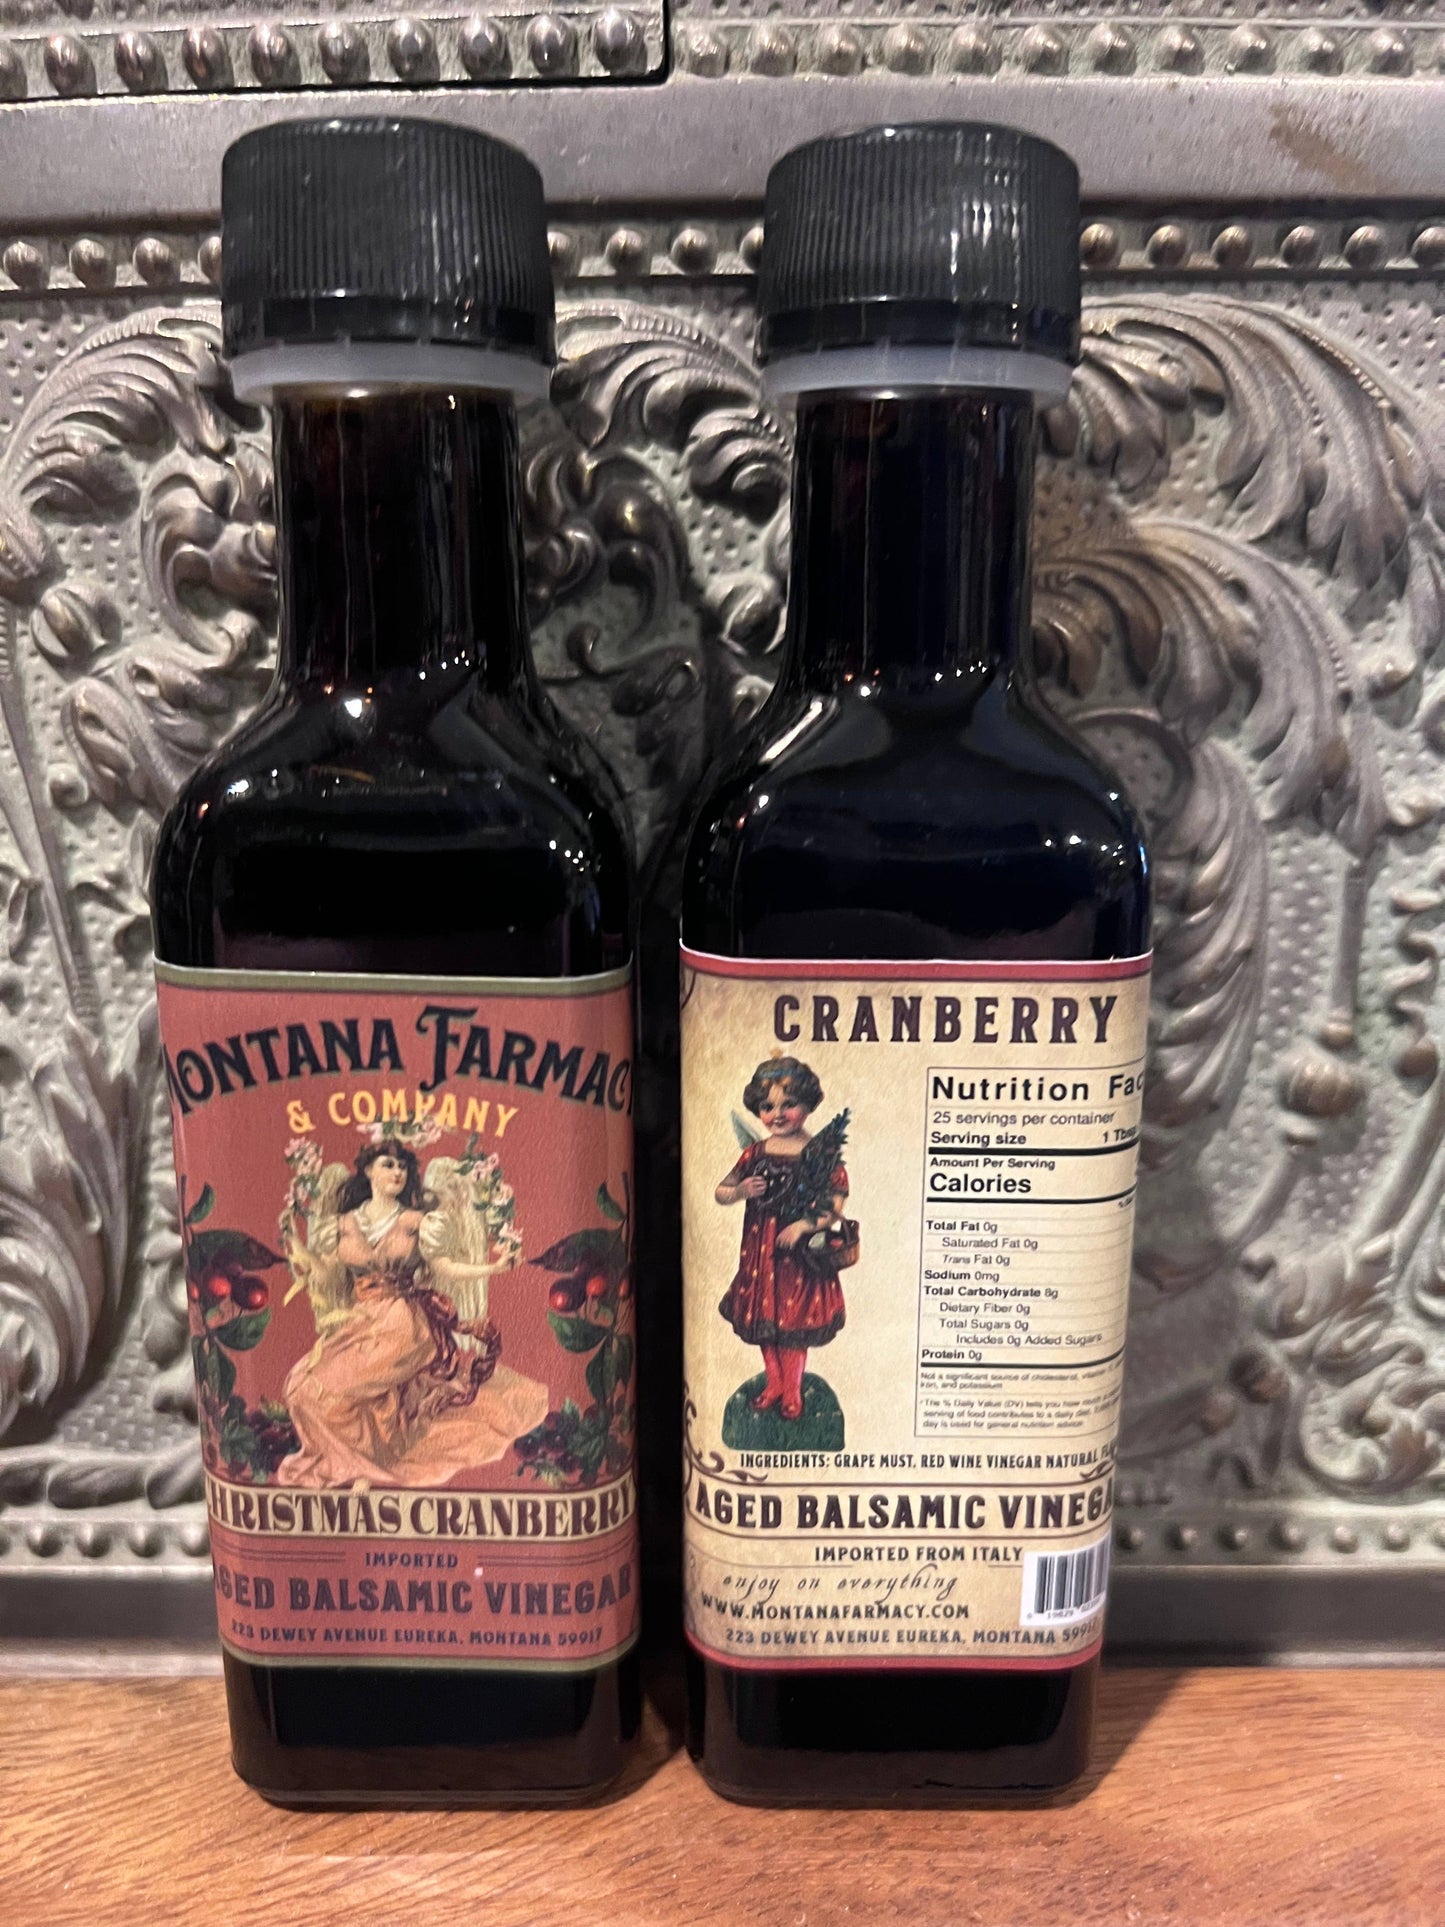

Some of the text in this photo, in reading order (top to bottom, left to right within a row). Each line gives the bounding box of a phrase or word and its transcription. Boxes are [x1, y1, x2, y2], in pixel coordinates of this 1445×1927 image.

[773, 994, 1118, 1044] CRANBERRY
[416, 1004, 633, 1116] FARMAC
[932, 1076, 1089, 1101] Nutrition
[286, 1088, 519, 1138] & COMPANY
[933, 1110, 1115, 1127] 25 servings per container
[931, 1131, 990, 1147] Serving
[996, 1131, 1027, 1145] size
[1103, 1131, 1109, 1143] 1
[930, 1157, 1056, 1171] Amount Per Serving
[930, 1173, 1032, 1194] Calories
[926, 1220, 998, 1234] Total Fat 0g
[942, 1237, 1038, 1250] Saturated Fat 0g
[943, 1254, 1010, 1267] Trans Fat 0g
[924, 1269, 1000, 1283] Sodium 0mg
[924, 1285, 954, 1296] Total
[958, 1286, 1041, 1299] Carbohydrate
[940, 1302, 1031, 1316] Dietary Fiber 0g
[939, 1319, 1029, 1332] Total Sugars 0g
[956, 1333, 1102, 1347] Includes 0g Added Sugars
[922, 1349, 983, 1361] Protein 0g
[740, 1452, 830, 1468] INGREDIENTS:
[834, 1453, 876, 1468] GRAPE
[921, 1454, 945, 1468] RED
[949, 1454, 982, 1469] WINE
[987, 1454, 1042, 1469] VINEGAR
[1046, 1447, 1099, 1469] NATURAL
[209, 1474, 401, 1534] HRISTMAS
[696, 1478, 782, 1529] AGED
[797, 1493, 986, 1529] BALSAMIC
[365, 1552, 459, 1569] IMPORTED
[815, 1546, 1023, 1561] IMPORTED FROM ITALY
[289, 1577, 473, 1613] BALSAMIC
[484, 1563, 631, 1616] VINEGAR
[724, 1563, 958, 1601] enjoy on everything
[701, 1591, 970, 1620] WWW.MONTANAFARMACY.COM
[260, 1627, 318, 1642] DEWEY
[323, 1628, 387, 1643] AVENUE
[395, 1628, 464, 1645] EUREKA,
[470, 1630, 551, 1646] MONTANA
[558, 1626, 603, 1646] 59917
[726, 1627, 754, 1642] 223
[760, 1629, 818, 1644] DEWEY
[824, 1629, 890, 1644] AVENUE
[896, 1629, 967, 1645] EUREKA,
[973, 1629, 1055, 1645] MONTANA
